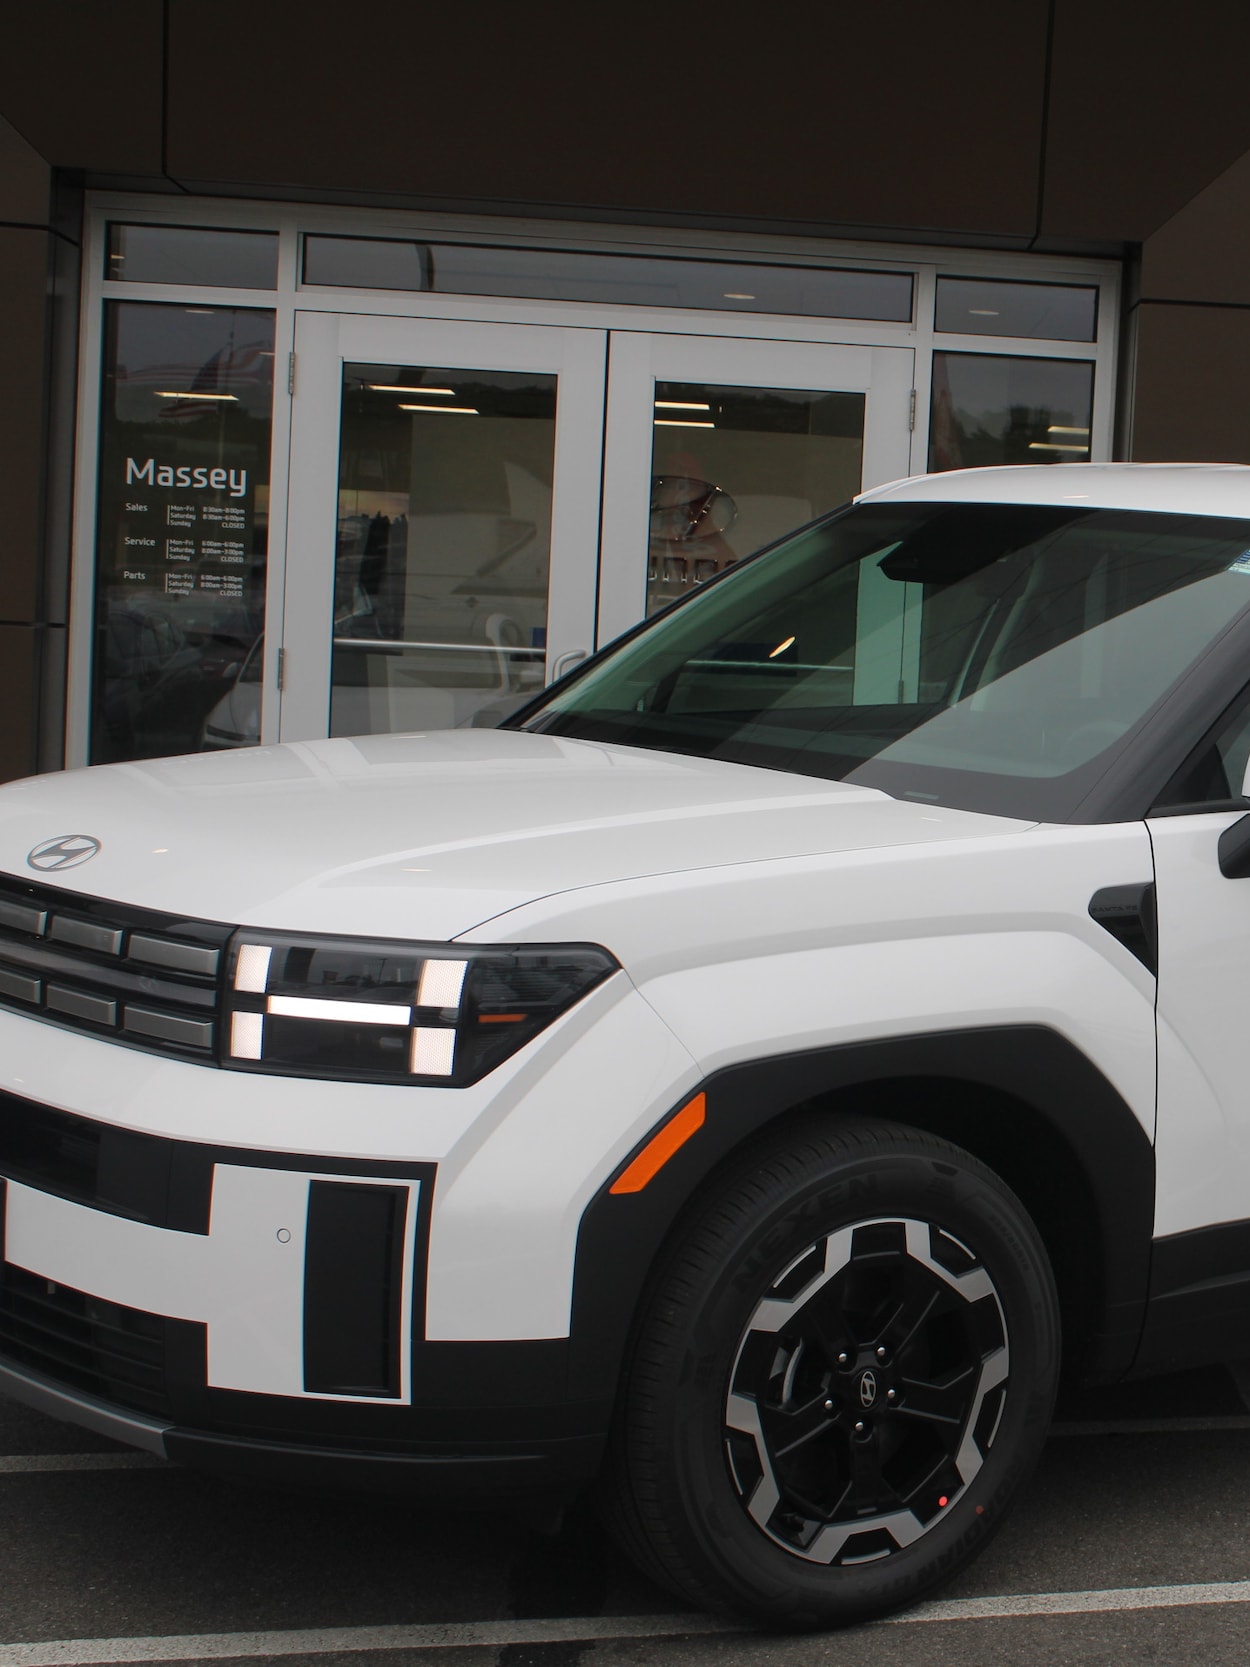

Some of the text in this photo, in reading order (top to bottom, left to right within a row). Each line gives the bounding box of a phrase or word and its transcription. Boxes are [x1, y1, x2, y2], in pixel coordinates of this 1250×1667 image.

[126, 457, 247, 497] Massey
[125, 502, 149, 512] Sales
[170, 512, 196, 520] Saturday
[170, 520, 192, 528] Sunday
[124, 537, 156, 547] Service
[169, 546, 195, 555] Saturday
[168, 554, 191, 562] Sunday
[123, 571, 147, 580] Parts
[168, 580, 194, 589] Saturday
[168, 588, 190, 596] Sunday
[731, 1173, 880, 1293] NEXEN
